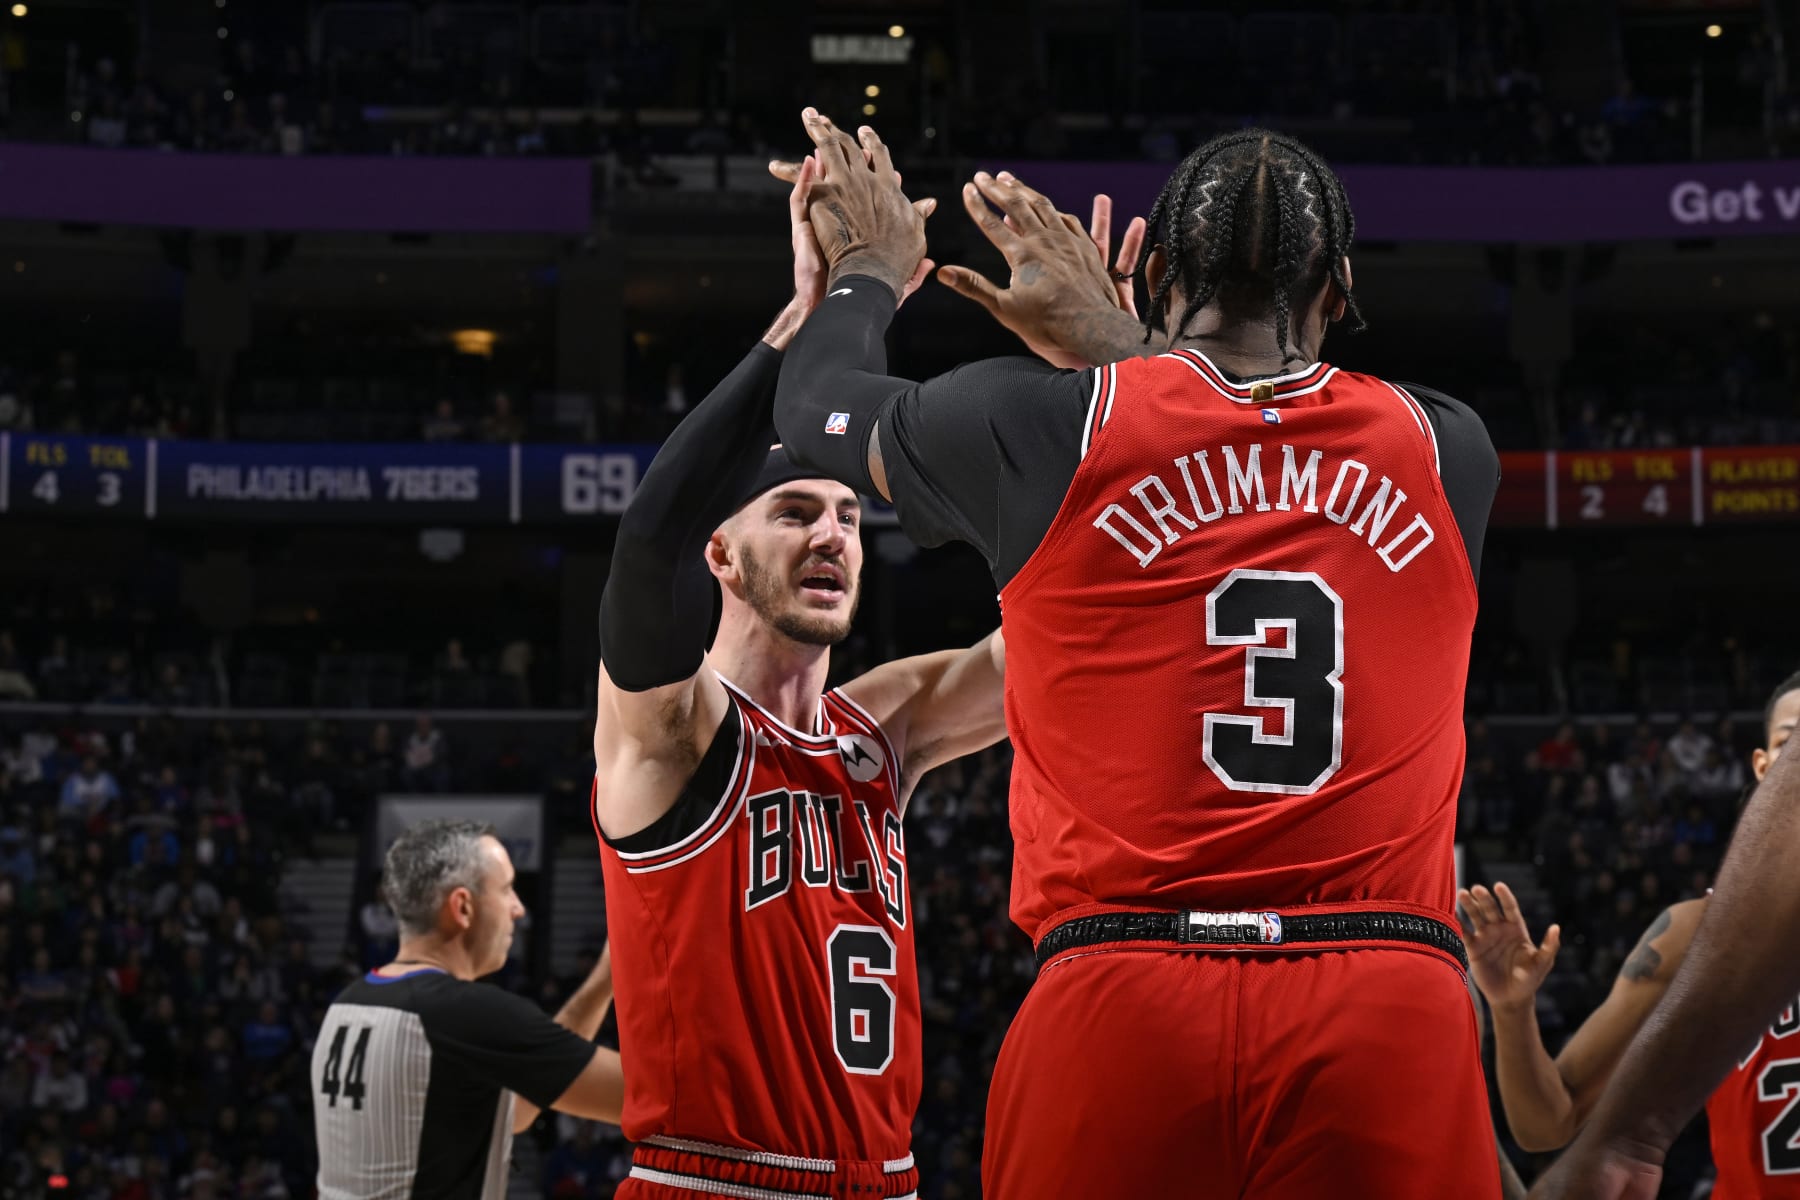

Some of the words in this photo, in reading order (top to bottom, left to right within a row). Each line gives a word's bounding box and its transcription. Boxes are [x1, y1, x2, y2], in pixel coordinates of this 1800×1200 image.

[1669, 180, 1763, 224] Get
[26, 442, 67, 466] FLS
[89, 444, 131, 468] TOL
[1571, 457, 1613, 482] FLS
[1632, 455, 1678, 480] TOL
[1709, 456, 1799, 483] PLAYER
[33, 470, 58, 504] 4
[97, 472, 121, 506] 3
[186, 463, 371, 500] PHILADELPHIA
[382, 466, 480, 501] 76ERS
[561, 453, 638, 515] 69
[1580, 485, 1604, 518] 2
[1642, 484, 1669, 516] 4
[1712, 489, 1799, 514] POINTS
[1093, 443, 1435, 573] DRUMMOND
[1202, 568, 1345, 796] 3
[745, 786, 906, 931] BULLS
[826, 923, 897, 1076] 6
[320, 1025, 372, 1111] 44
